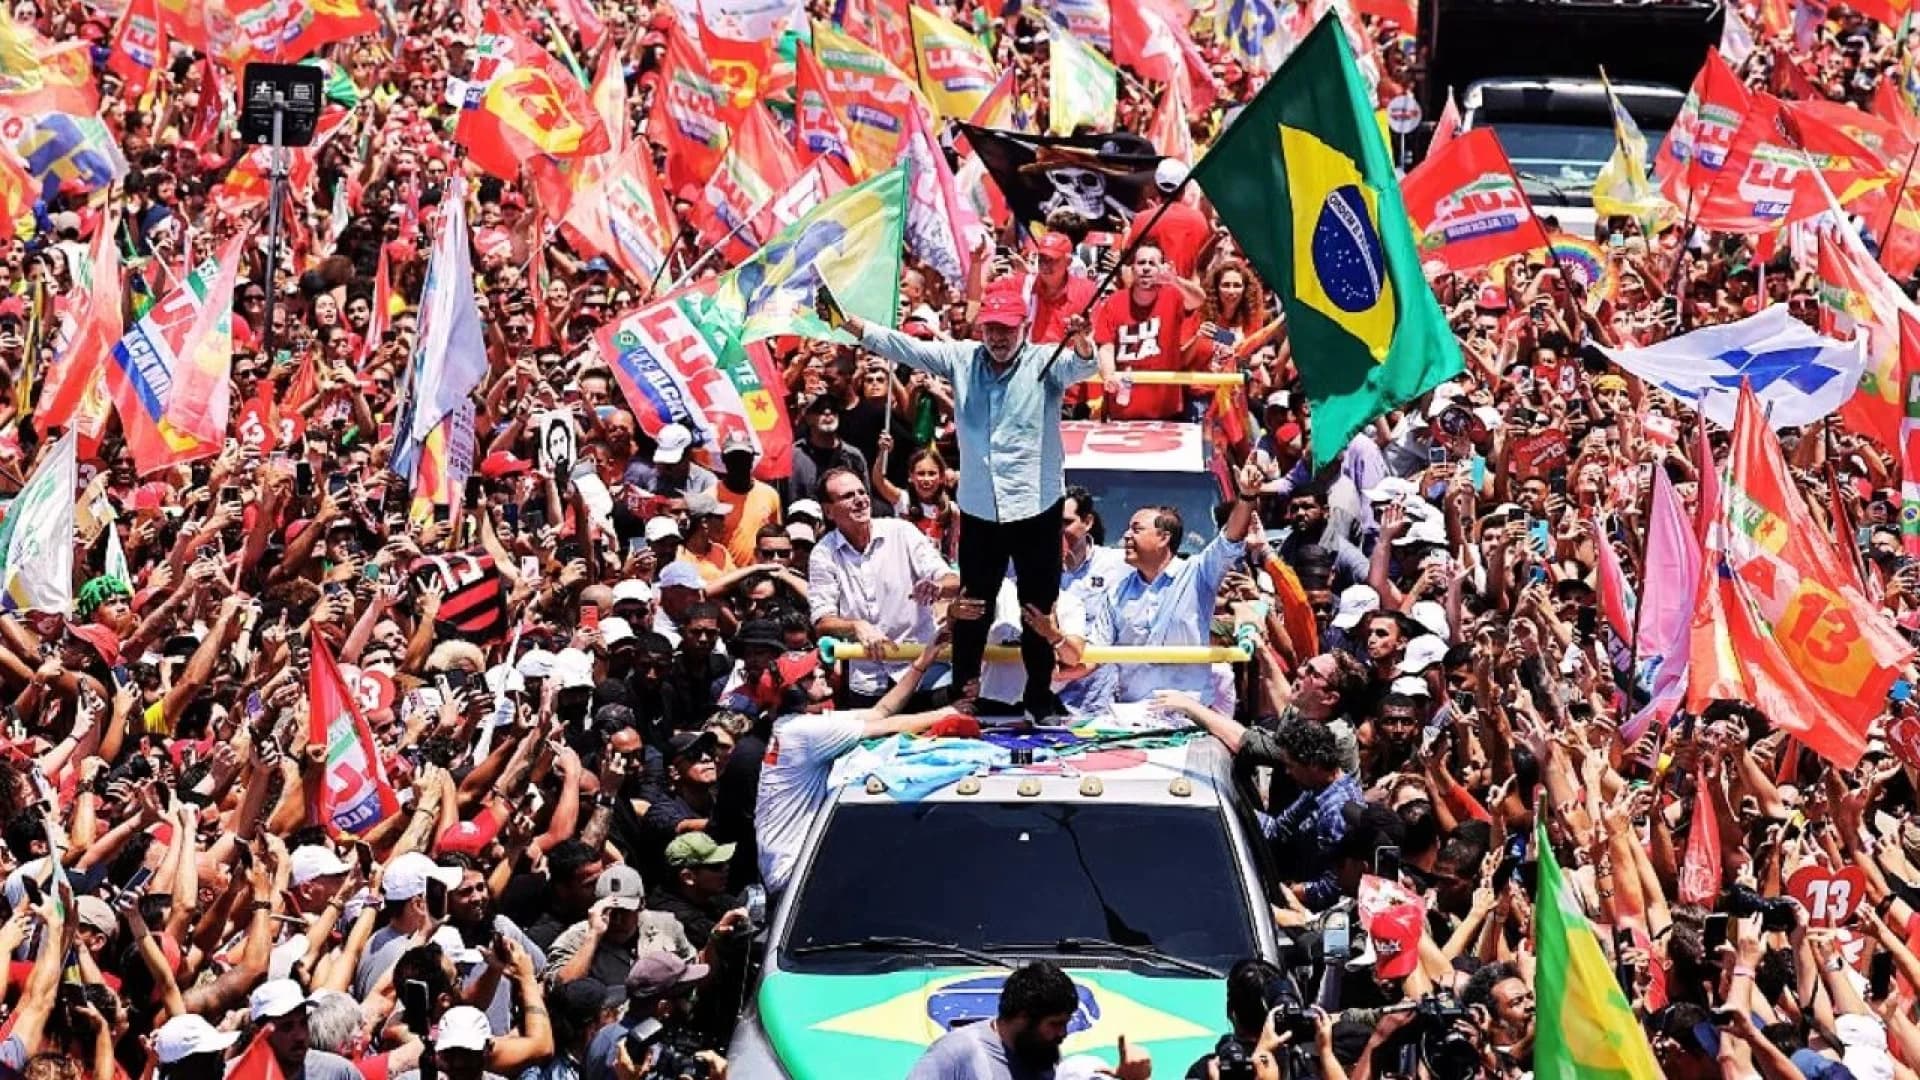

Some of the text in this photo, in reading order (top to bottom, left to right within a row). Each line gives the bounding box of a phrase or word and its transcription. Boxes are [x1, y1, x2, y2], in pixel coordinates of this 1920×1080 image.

[1118, 317, 1160, 343] LU
[1116, 339, 1161, 361] LA
[1090, 575, 1105, 588] 13
[1790, 592, 1862, 665] 13
[1806, 879, 1851, 919] 13
